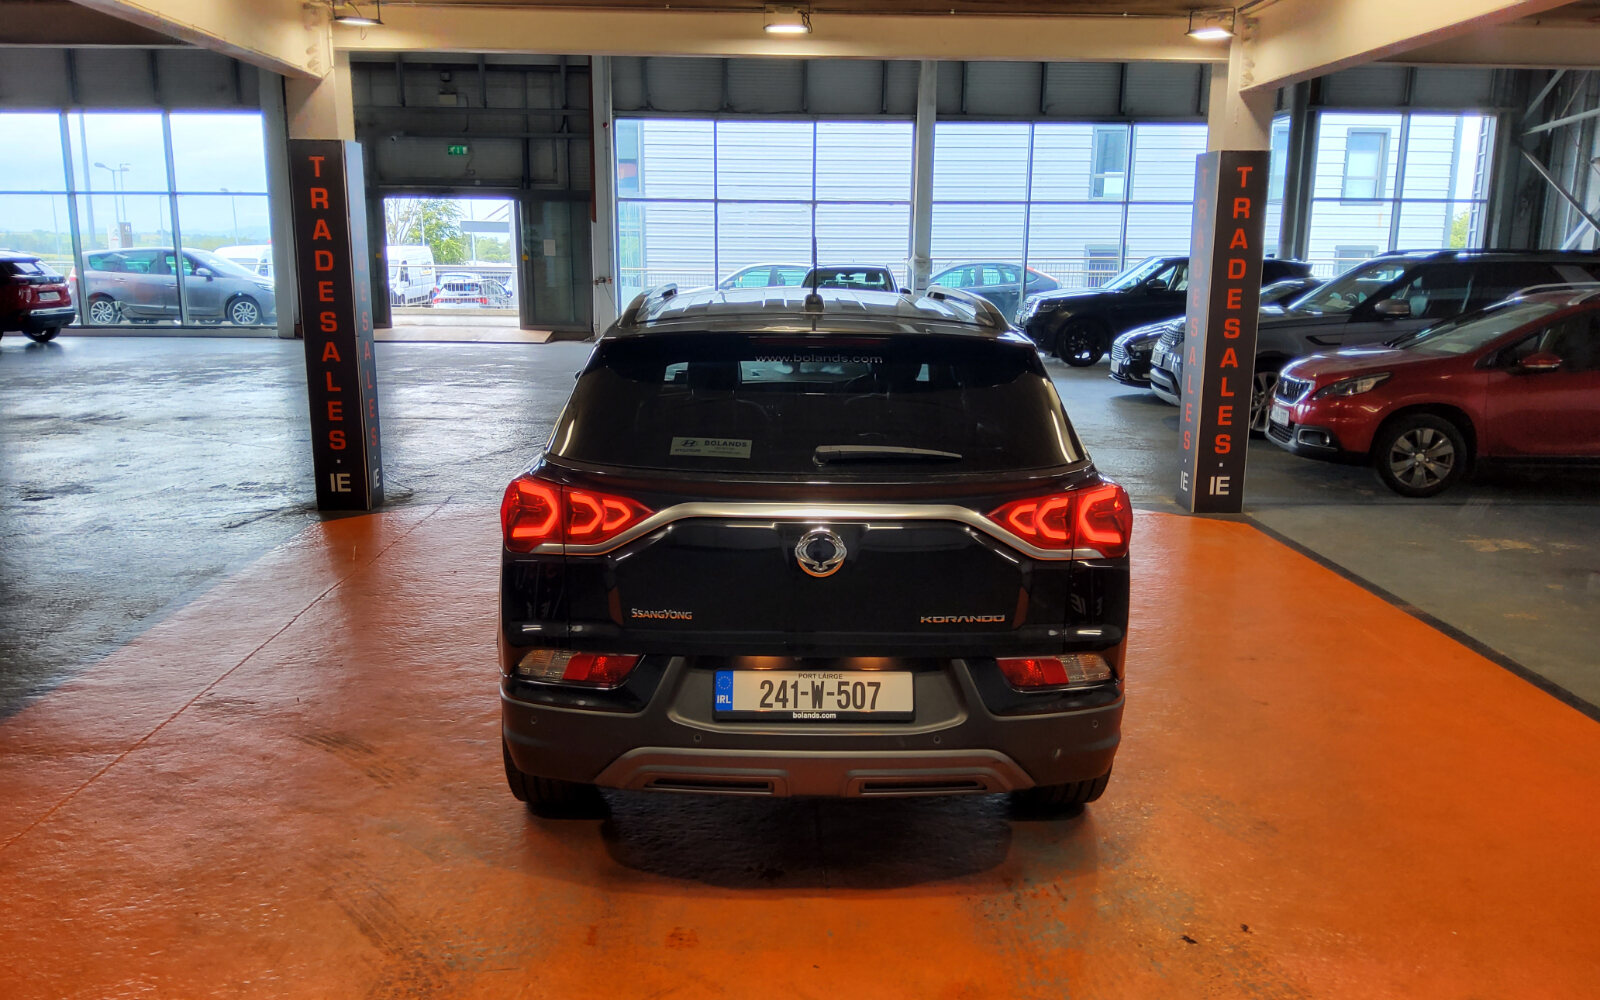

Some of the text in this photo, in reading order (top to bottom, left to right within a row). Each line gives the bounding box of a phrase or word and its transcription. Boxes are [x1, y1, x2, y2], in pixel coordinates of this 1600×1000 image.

[755, 354, 883, 364] www.bolands.com
[704, 440, 747, 448] BOLANDS
[920, 615, 1005, 623] KORANDO
[759, 680, 881, 710] 241-W-507
[716, 695, 731, 704] IRL
[792, 711, 837, 719] bolands.com
